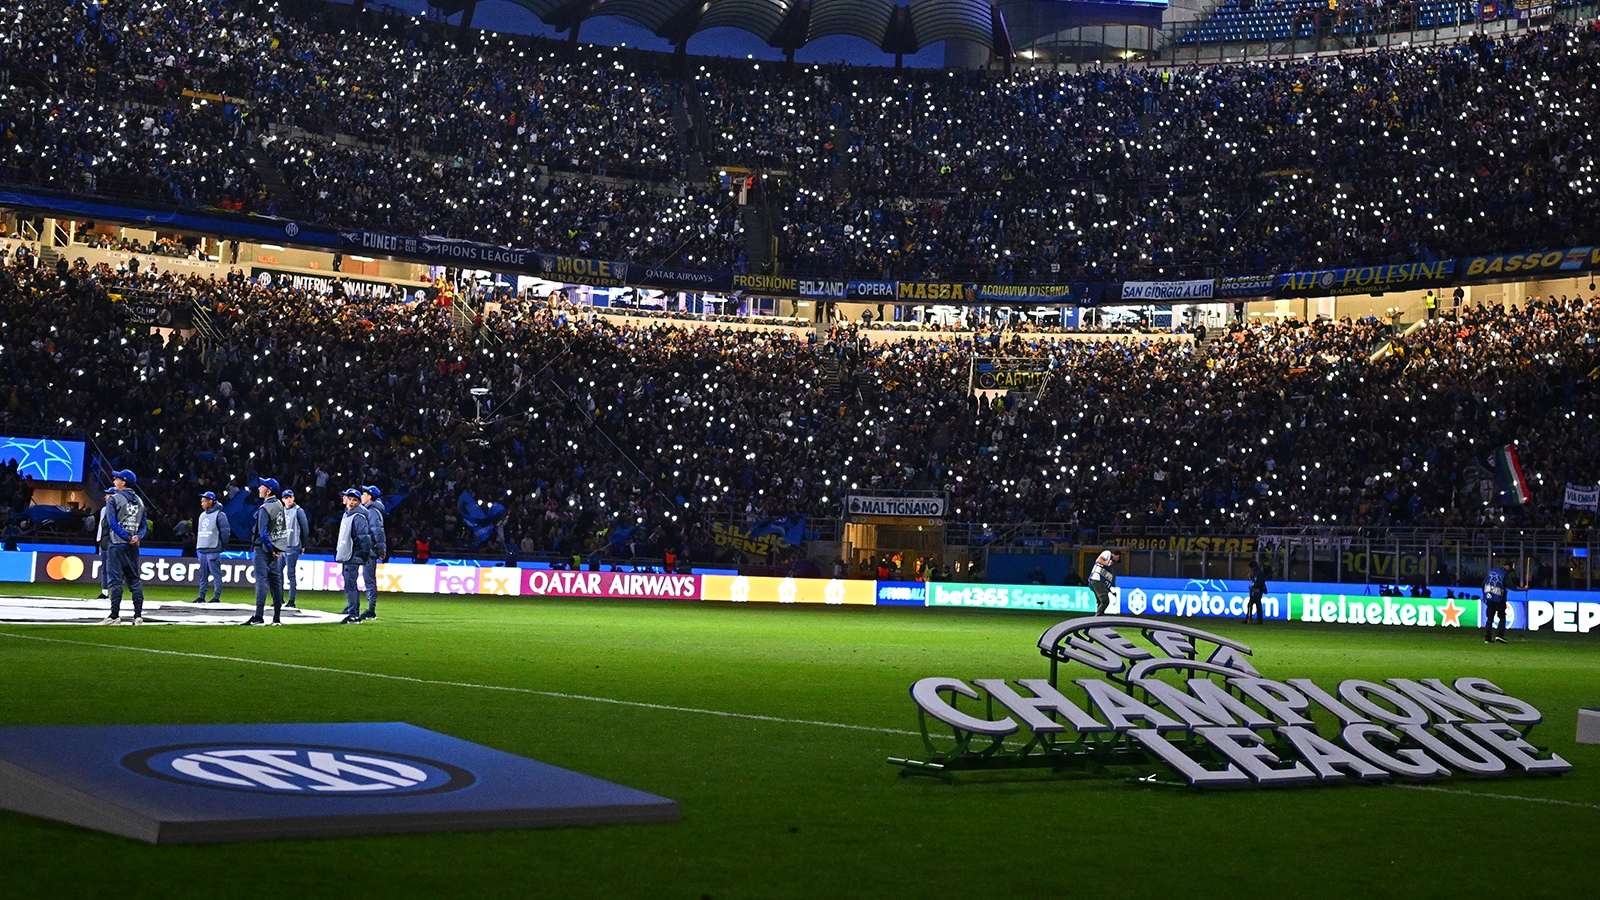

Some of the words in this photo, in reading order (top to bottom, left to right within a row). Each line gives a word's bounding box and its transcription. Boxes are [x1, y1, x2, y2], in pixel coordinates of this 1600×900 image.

[481, 251, 525, 265] LEAGUE
[557, 256, 611, 277] MOLE
[1467, 251, 1563, 275] BASSO
[646, 269, 676, 280] QATAR
[677, 272, 714, 283] AIRWAYS
[733, 275, 797, 290] FROSINONE
[1343, 260, 1450, 287] POLESINE
[800, 280, 844, 296] BOLZANO
[858, 283, 893, 296] OPERA
[899, 283, 964, 300] MASSA
[981, 285, 1028, 297] ACQUAVIVA
[1029, 285, 1070, 298] D'ISERNIA
[1123, 286, 1142, 298] SAN
[1144, 286, 1183, 298] GIORGIO
[1183, 286, 1191, 297] A
[1193, 284, 1212, 297] LIRI
[1221, 281, 1273, 290] MOZZATE
[1330, 285, 1391, 295] BARUCHELLA
[861, 501, 939, 515] MALTIGNANO
[1115, 537, 1167, 550] TURBIGO
[1169, 535, 1255, 559] MESTRE
[1342, 551, 1437, 577] ROVIGO
[435, 565, 510, 595] FedEx
[529, 571, 602, 595] QATAR
[608, 574, 695, 597] AIRWAYS
[935, 586, 1009, 607] bet365
[1011, 589, 1090, 610] Scores.it
[1301, 593, 1436, 627] Heineken
[1061, 627, 1264, 678] UEFA
[910, 677, 1543, 736] CHAMPIONS
[1124, 722, 1574, 787] LEAGUE
